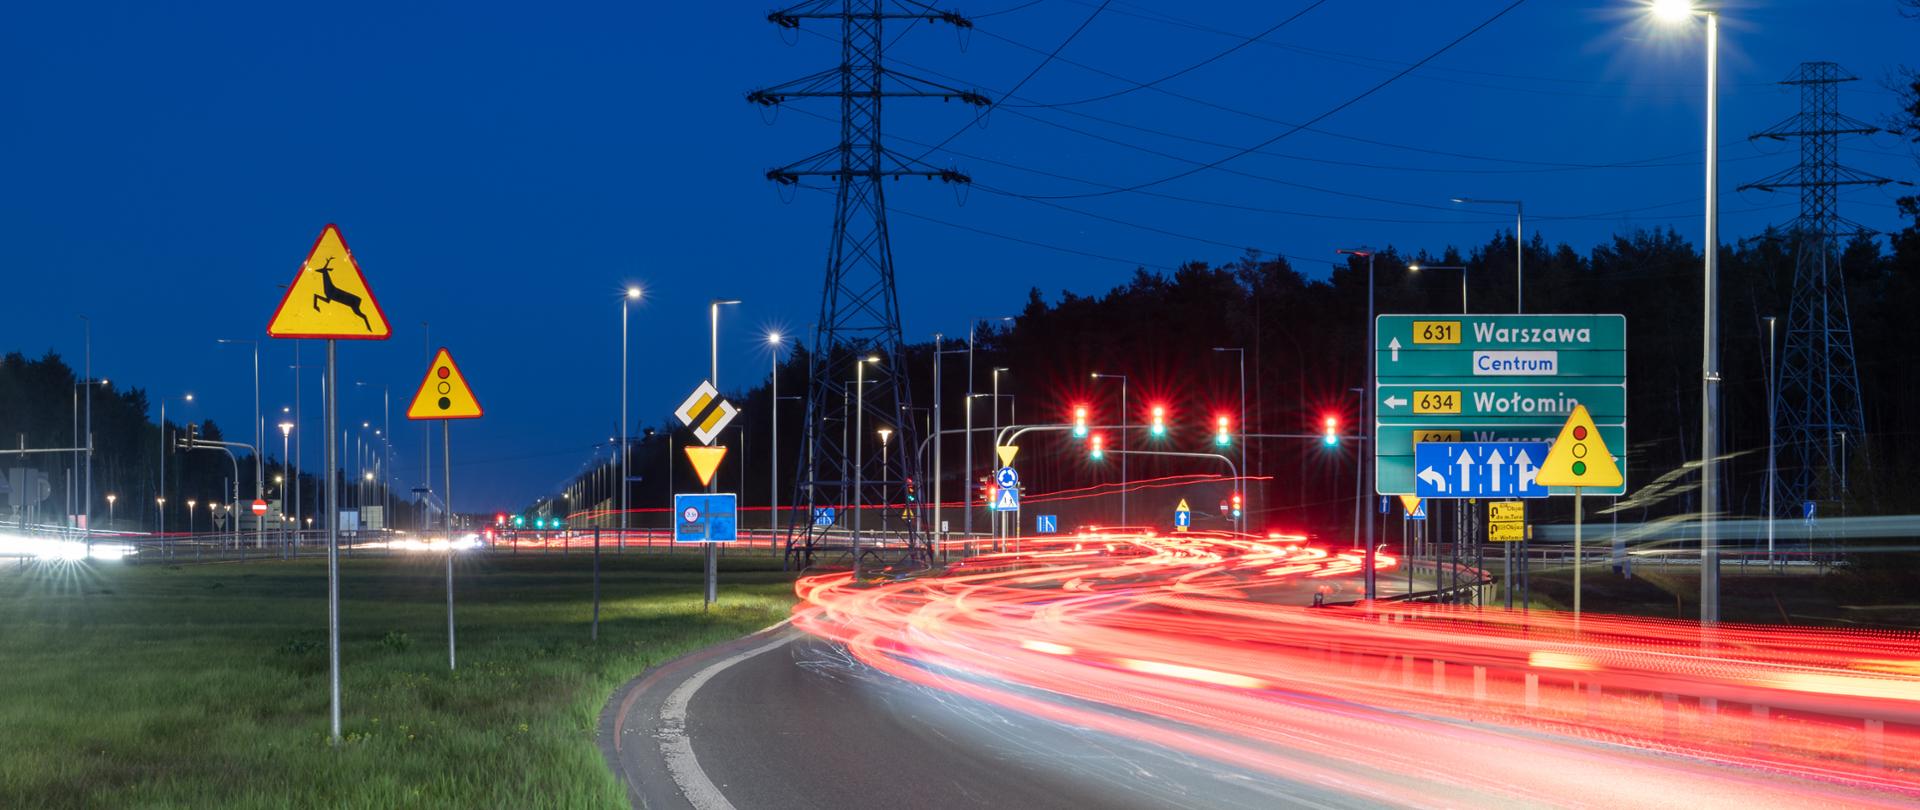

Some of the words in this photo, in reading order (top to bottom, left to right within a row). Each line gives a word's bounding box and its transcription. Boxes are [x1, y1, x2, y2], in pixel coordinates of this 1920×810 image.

[1423, 324, 1451, 341] 631
[1473, 322, 1591, 343] Warszawa
[1478, 355, 1553, 371] Centrum
[1421, 394, 1453, 410] 634
